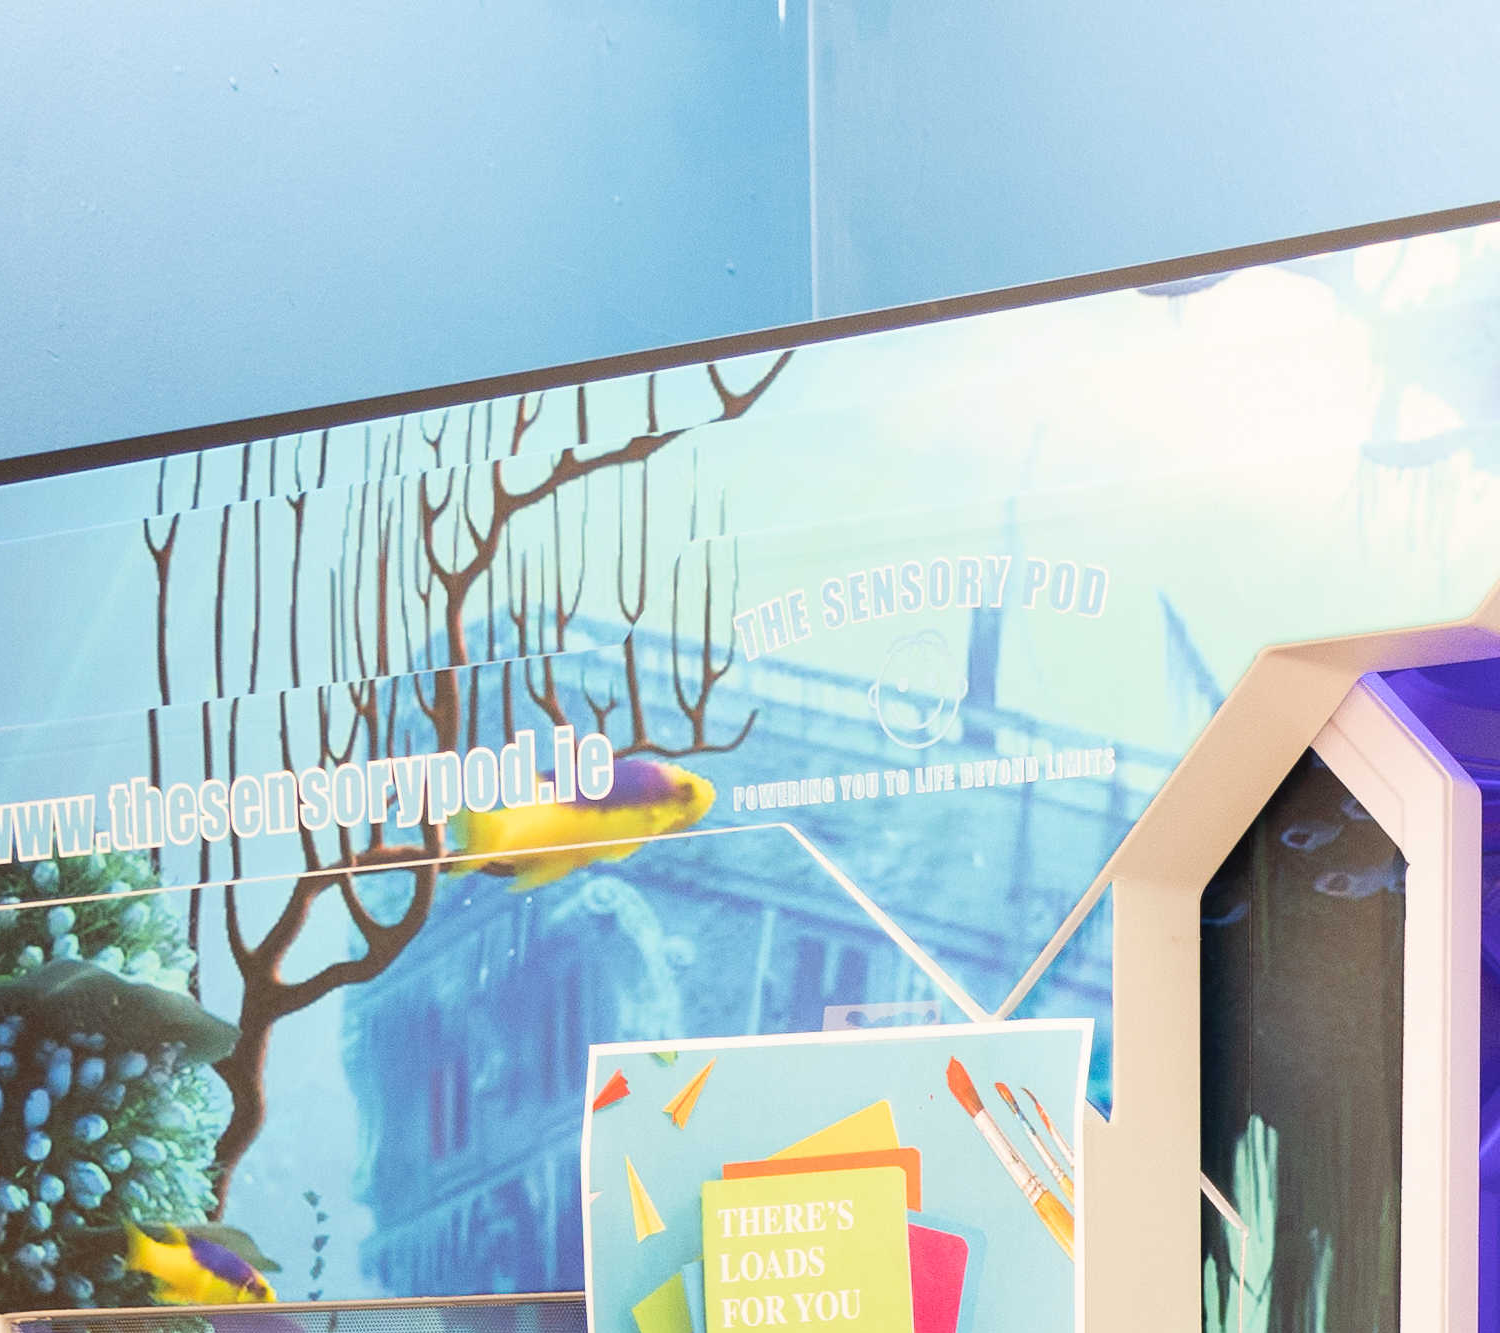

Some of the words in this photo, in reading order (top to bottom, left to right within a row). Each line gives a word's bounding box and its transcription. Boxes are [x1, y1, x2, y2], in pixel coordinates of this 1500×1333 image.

[733, 588, 812, 662] THE
[821, 555, 1012, 631] SENSORY
[1022, 555, 1110, 618] POD
[733, 778, 835, 812] POWERING
[839, 773, 879, 801] YOU
[884, 769, 910, 796] TO
[915, 763, 956, 793] LIFE
[960, 756, 1039, 789] BEYOND
[1045, 747, 1116, 781] LIMITS
[719, 1247, 825, 1283] LOADS
[721, 1295, 788, 1328] FOR
[793, 1289, 861, 1323] YOU
